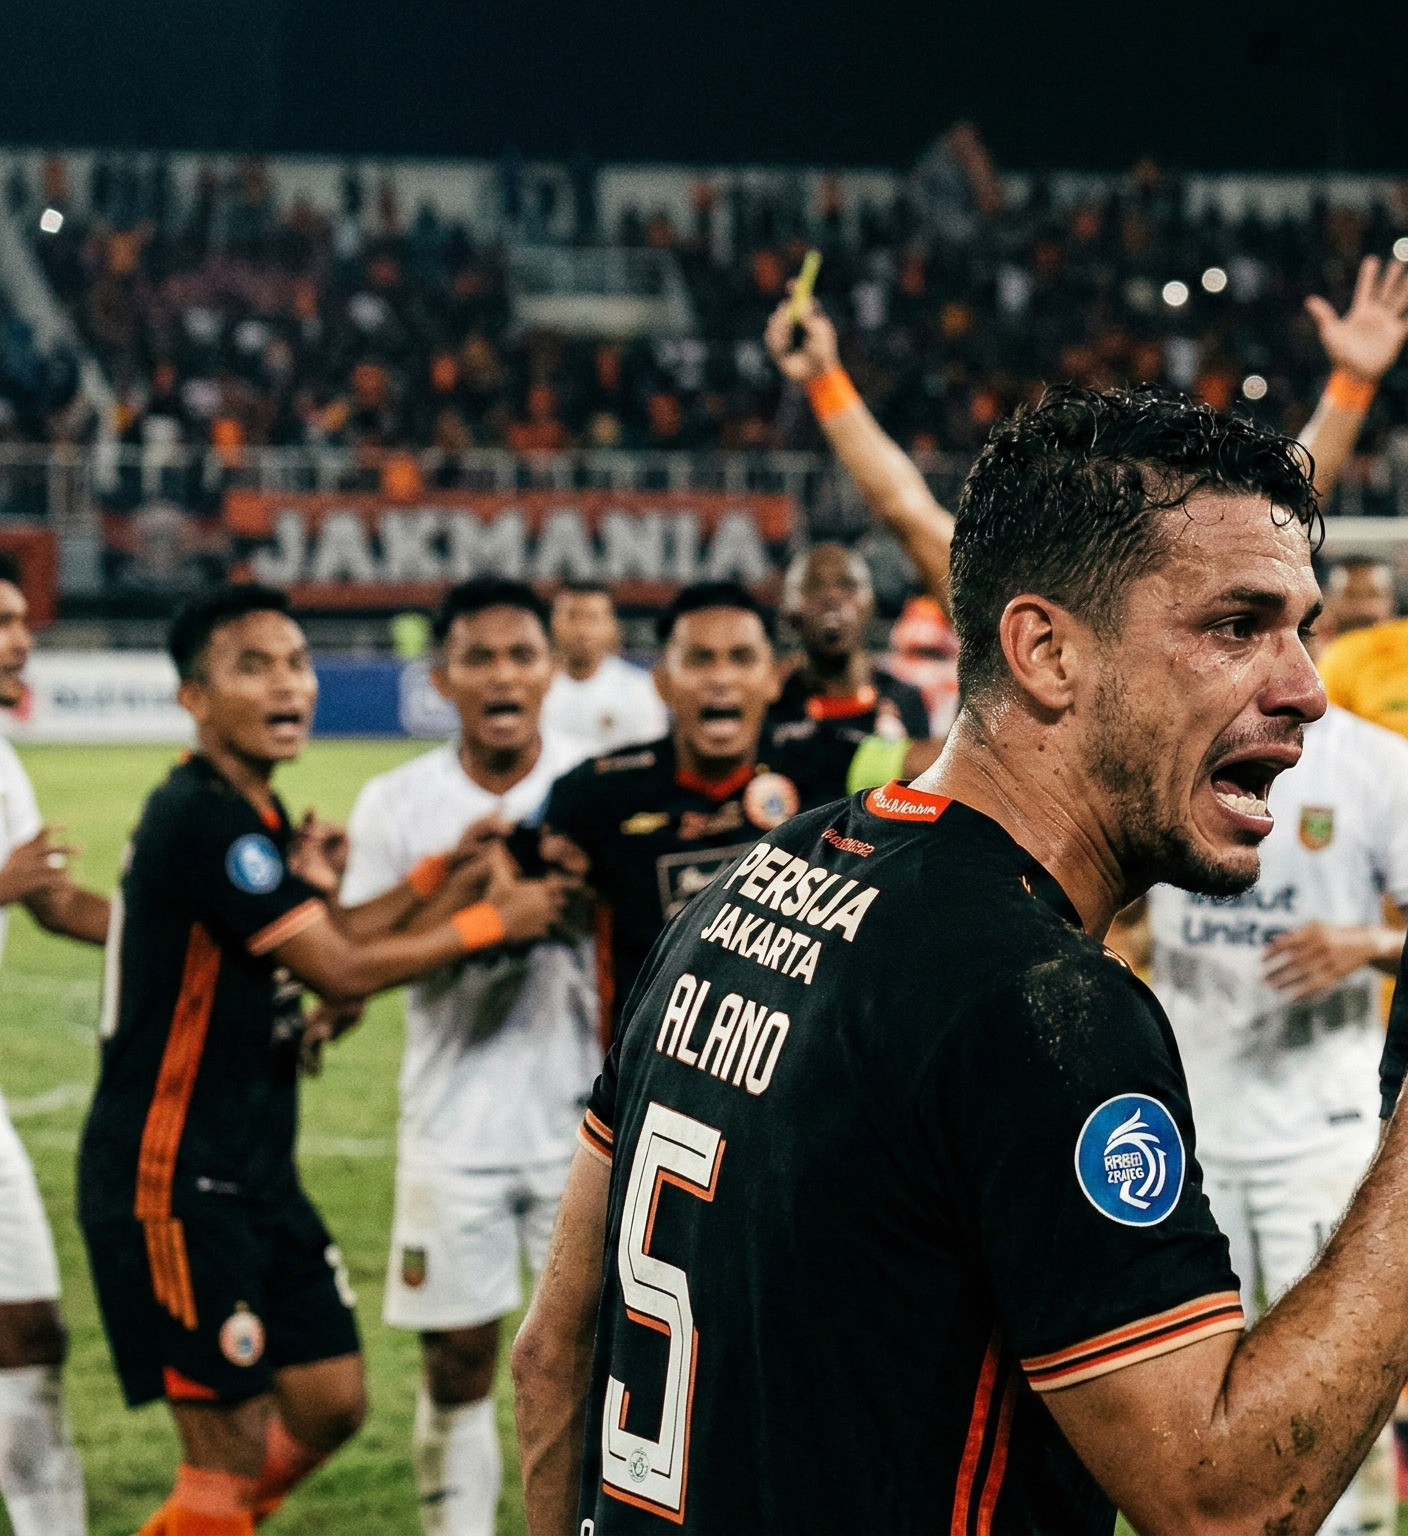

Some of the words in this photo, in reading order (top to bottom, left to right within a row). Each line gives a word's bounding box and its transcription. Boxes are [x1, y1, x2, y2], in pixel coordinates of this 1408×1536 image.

[253, 509, 776, 584] JAKMANIA
[722, 842, 880, 942] PERSIJA
[700, 902, 822, 985] JAKARTA
[655, 972, 790, 1096] ALANO
[602, 1101, 726, 1525] 5
